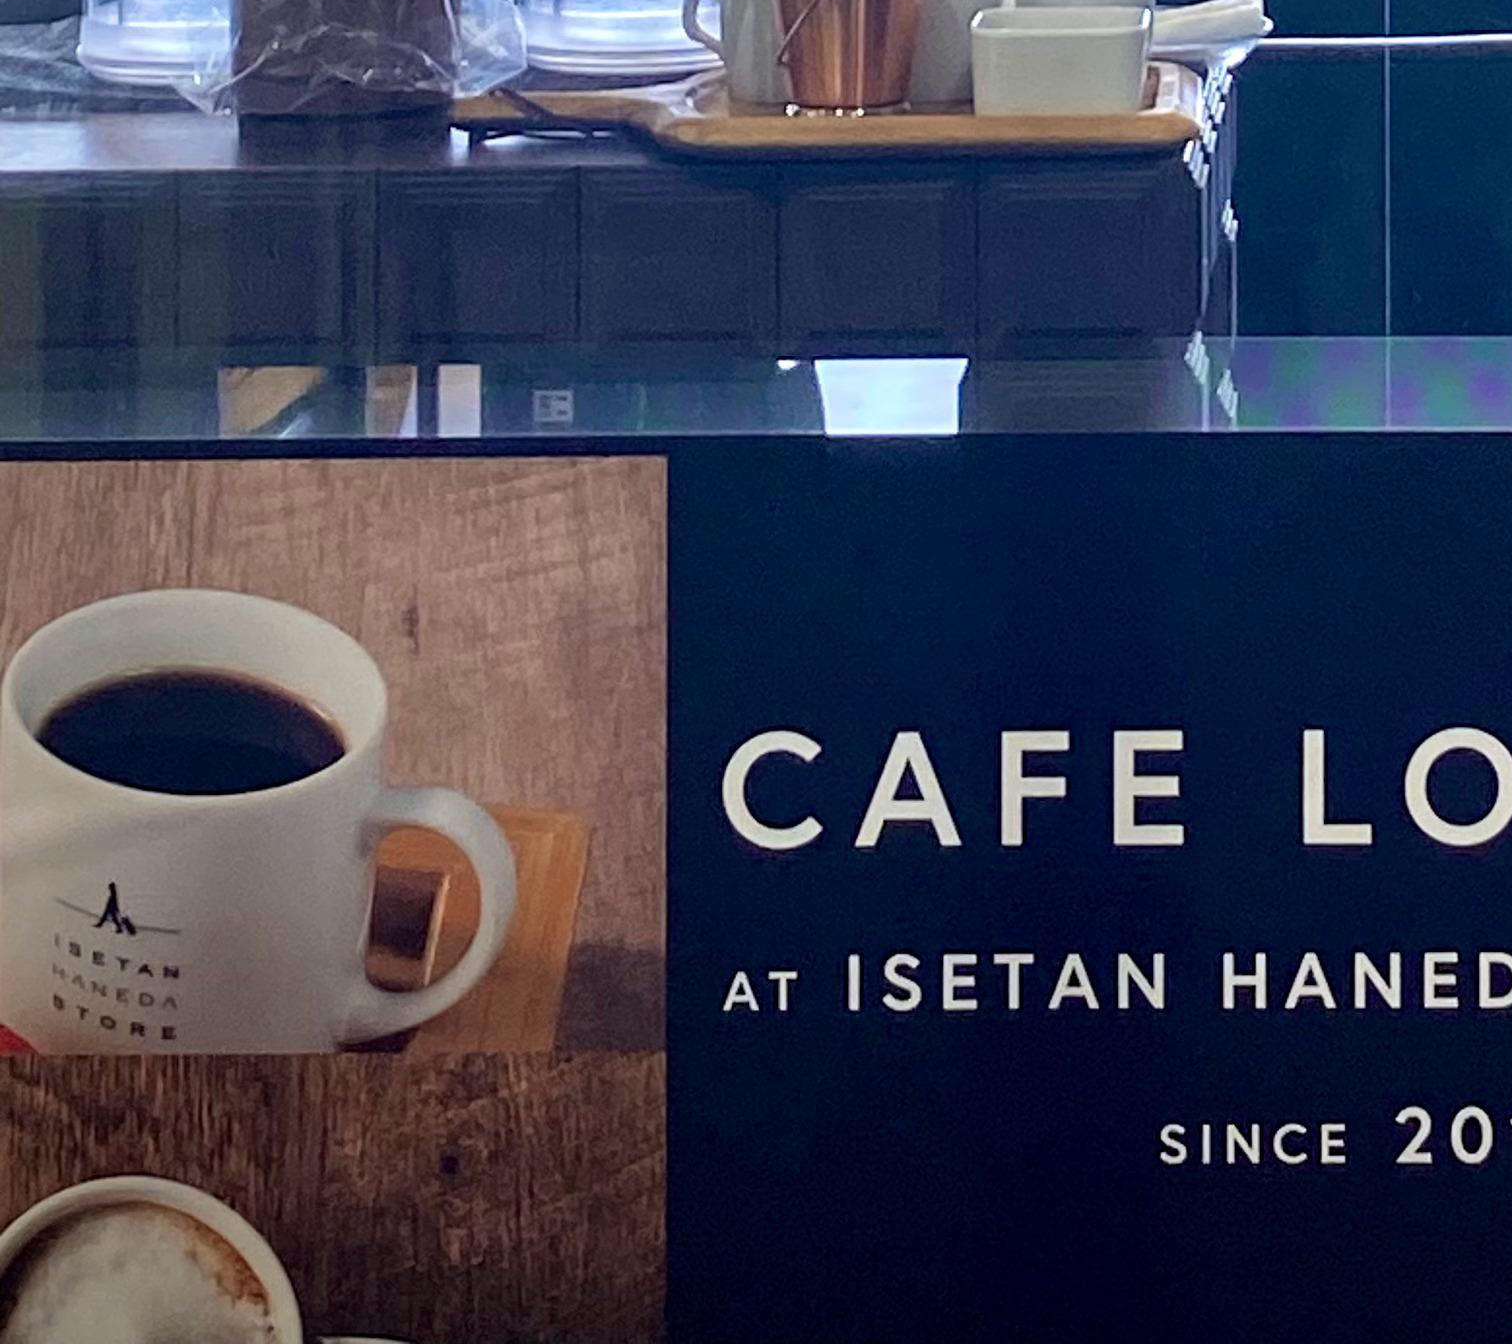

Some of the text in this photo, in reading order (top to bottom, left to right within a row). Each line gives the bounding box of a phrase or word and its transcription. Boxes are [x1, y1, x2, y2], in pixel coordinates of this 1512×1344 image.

[721, 729, 1185, 851] CAFE
[722, 970, 799, 1012] AT
[847, 953, 1166, 1012] ISETAN
[1158, 1122, 1348, 1166] SINCE
